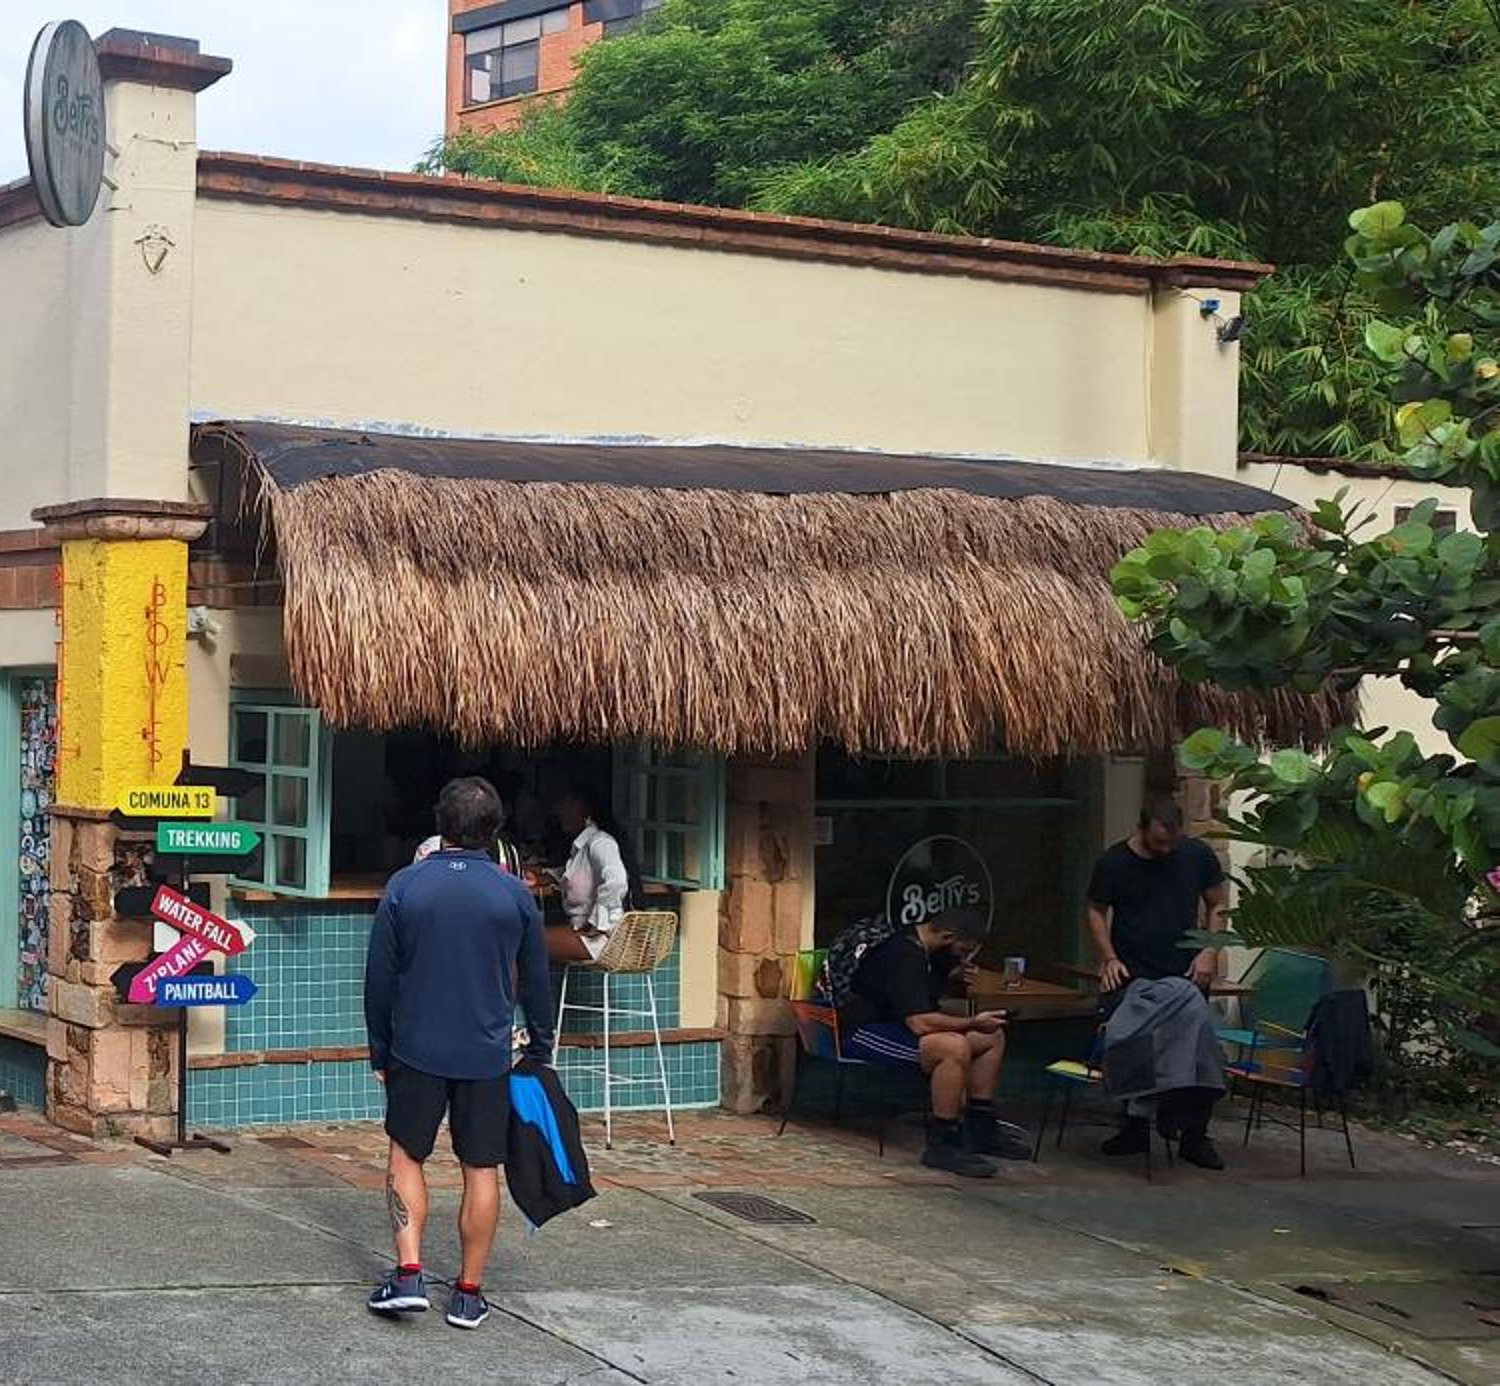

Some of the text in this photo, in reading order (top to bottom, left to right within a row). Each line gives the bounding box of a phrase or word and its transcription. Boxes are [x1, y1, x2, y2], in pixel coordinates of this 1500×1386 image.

[129, 791, 210, 809] COMUNA 13
[167, 829, 242, 849] TREKKING
[158, 893, 233, 950] WATER FALL
[165, 981, 239, 1001] PAINTBALL
